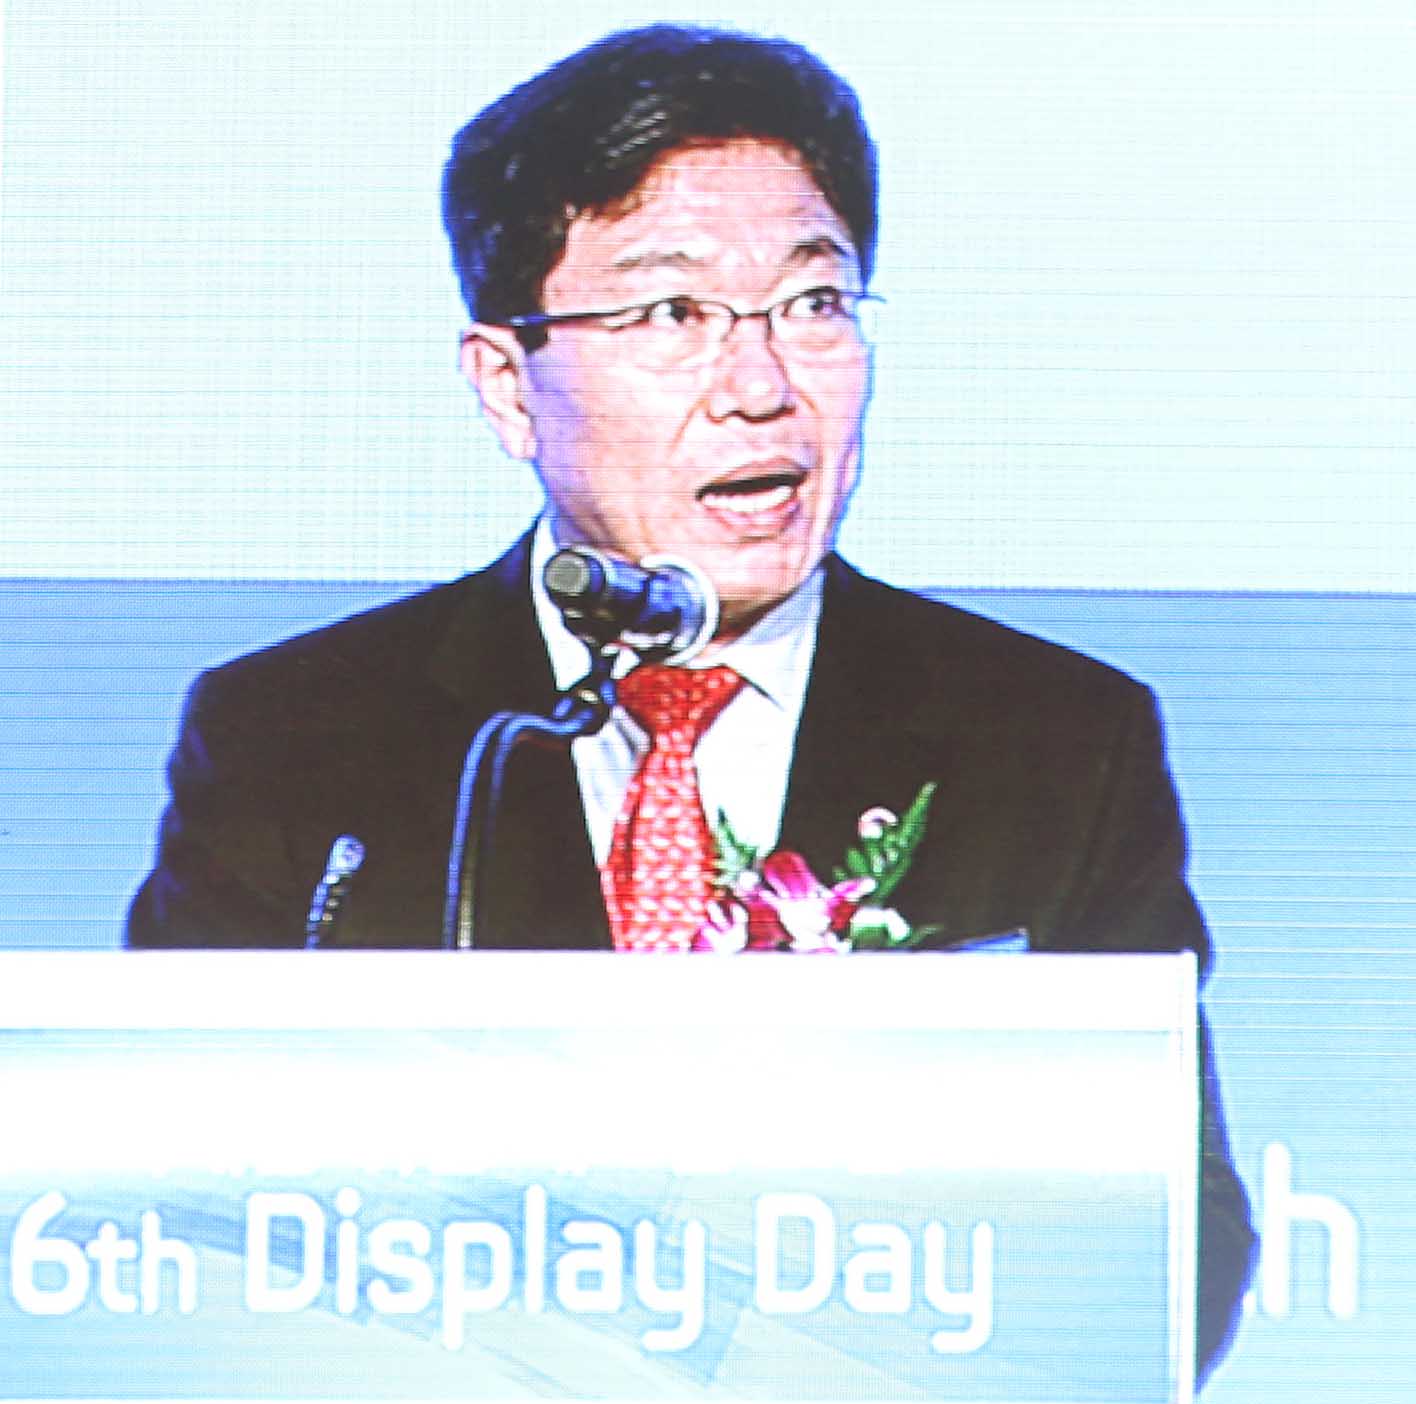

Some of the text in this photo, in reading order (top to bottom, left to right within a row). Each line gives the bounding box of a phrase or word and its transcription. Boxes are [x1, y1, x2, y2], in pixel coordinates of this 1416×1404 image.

[8, 1185, 995, 1354] 6th Display Day
